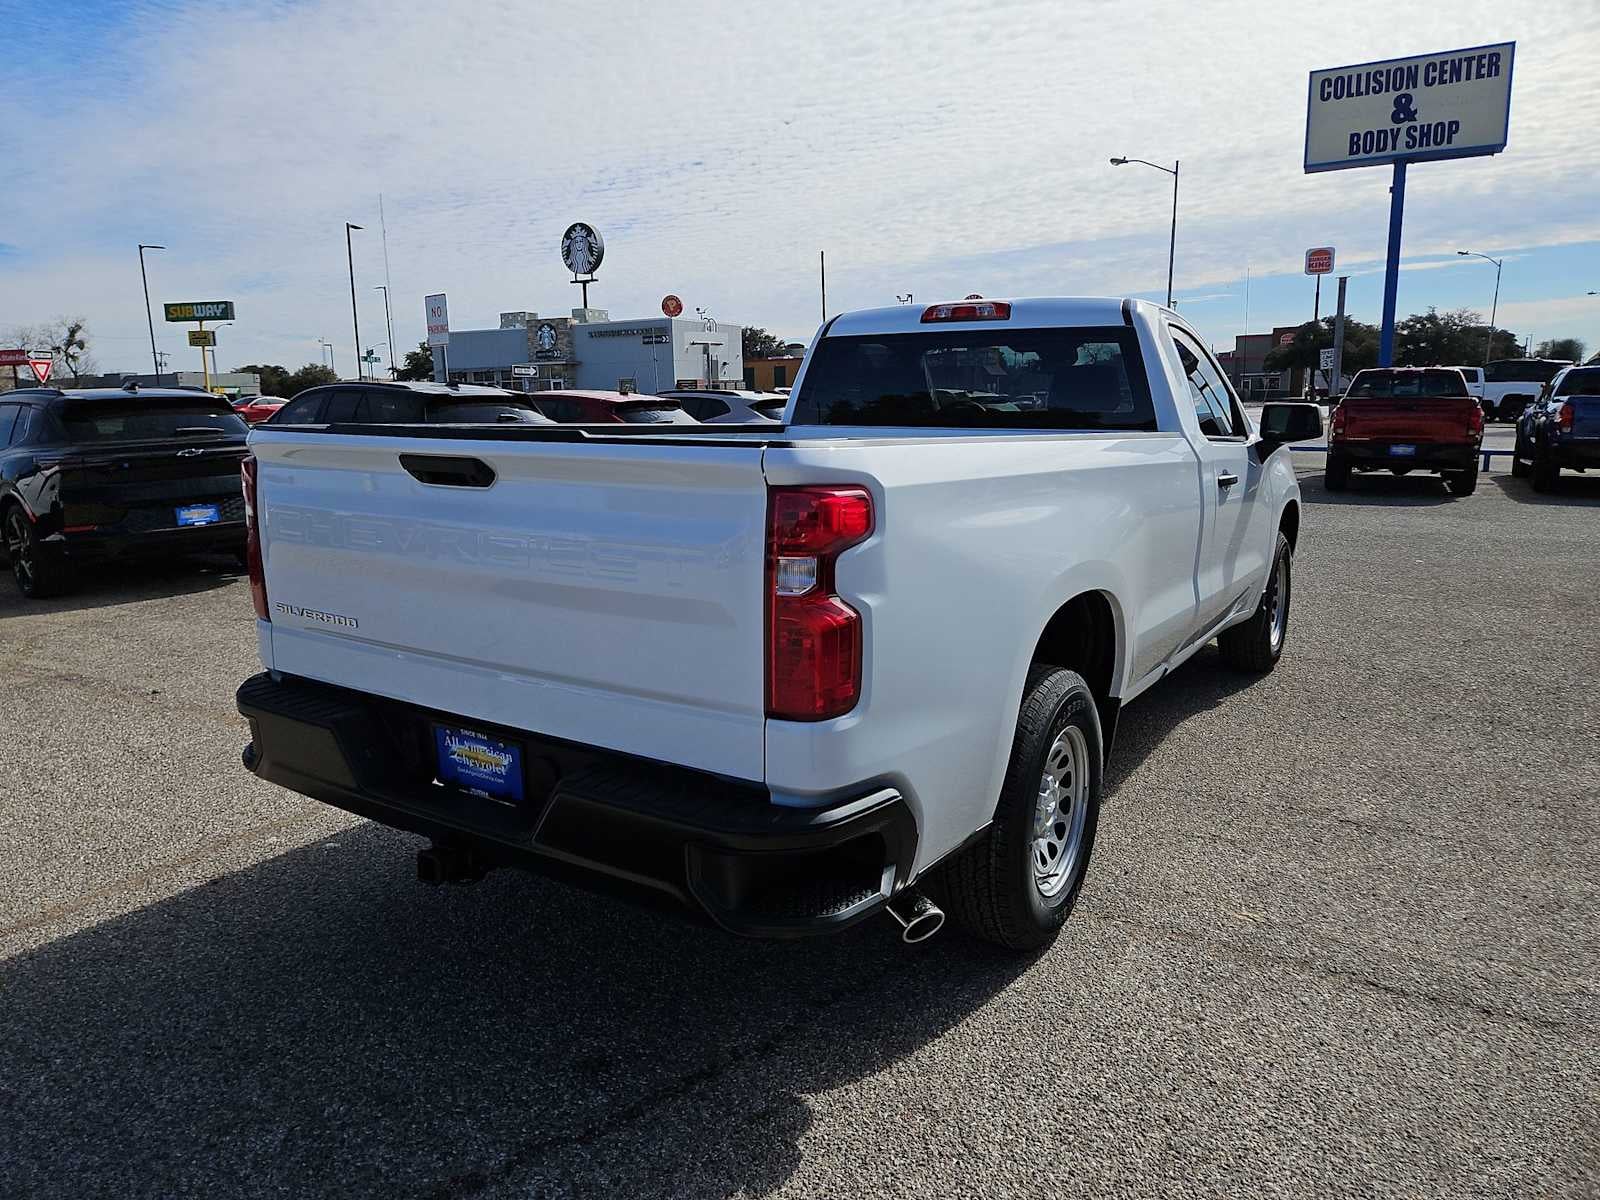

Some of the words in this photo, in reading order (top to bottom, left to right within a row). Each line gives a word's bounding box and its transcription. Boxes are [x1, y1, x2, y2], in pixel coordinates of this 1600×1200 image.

[1319, 64, 1420, 102] COLLISION
[1424, 52, 1501, 88] CENTER
[1391, 93, 1418, 125] &
[1348, 128, 1402, 156] BODY
[1405, 120, 1460, 149] SHOP
[1309, 261, 1331, 269] KING
[169, 304, 226, 318] SUBWAY
[431, 306, 442, 317] NO
[428, 325, 449, 334] PARKING
[275, 601, 359, 628] SILVERADO
[444, 735, 459, 749] All
[464, 740, 513, 763] American
[455, 751, 507, 776] Chevrolet
